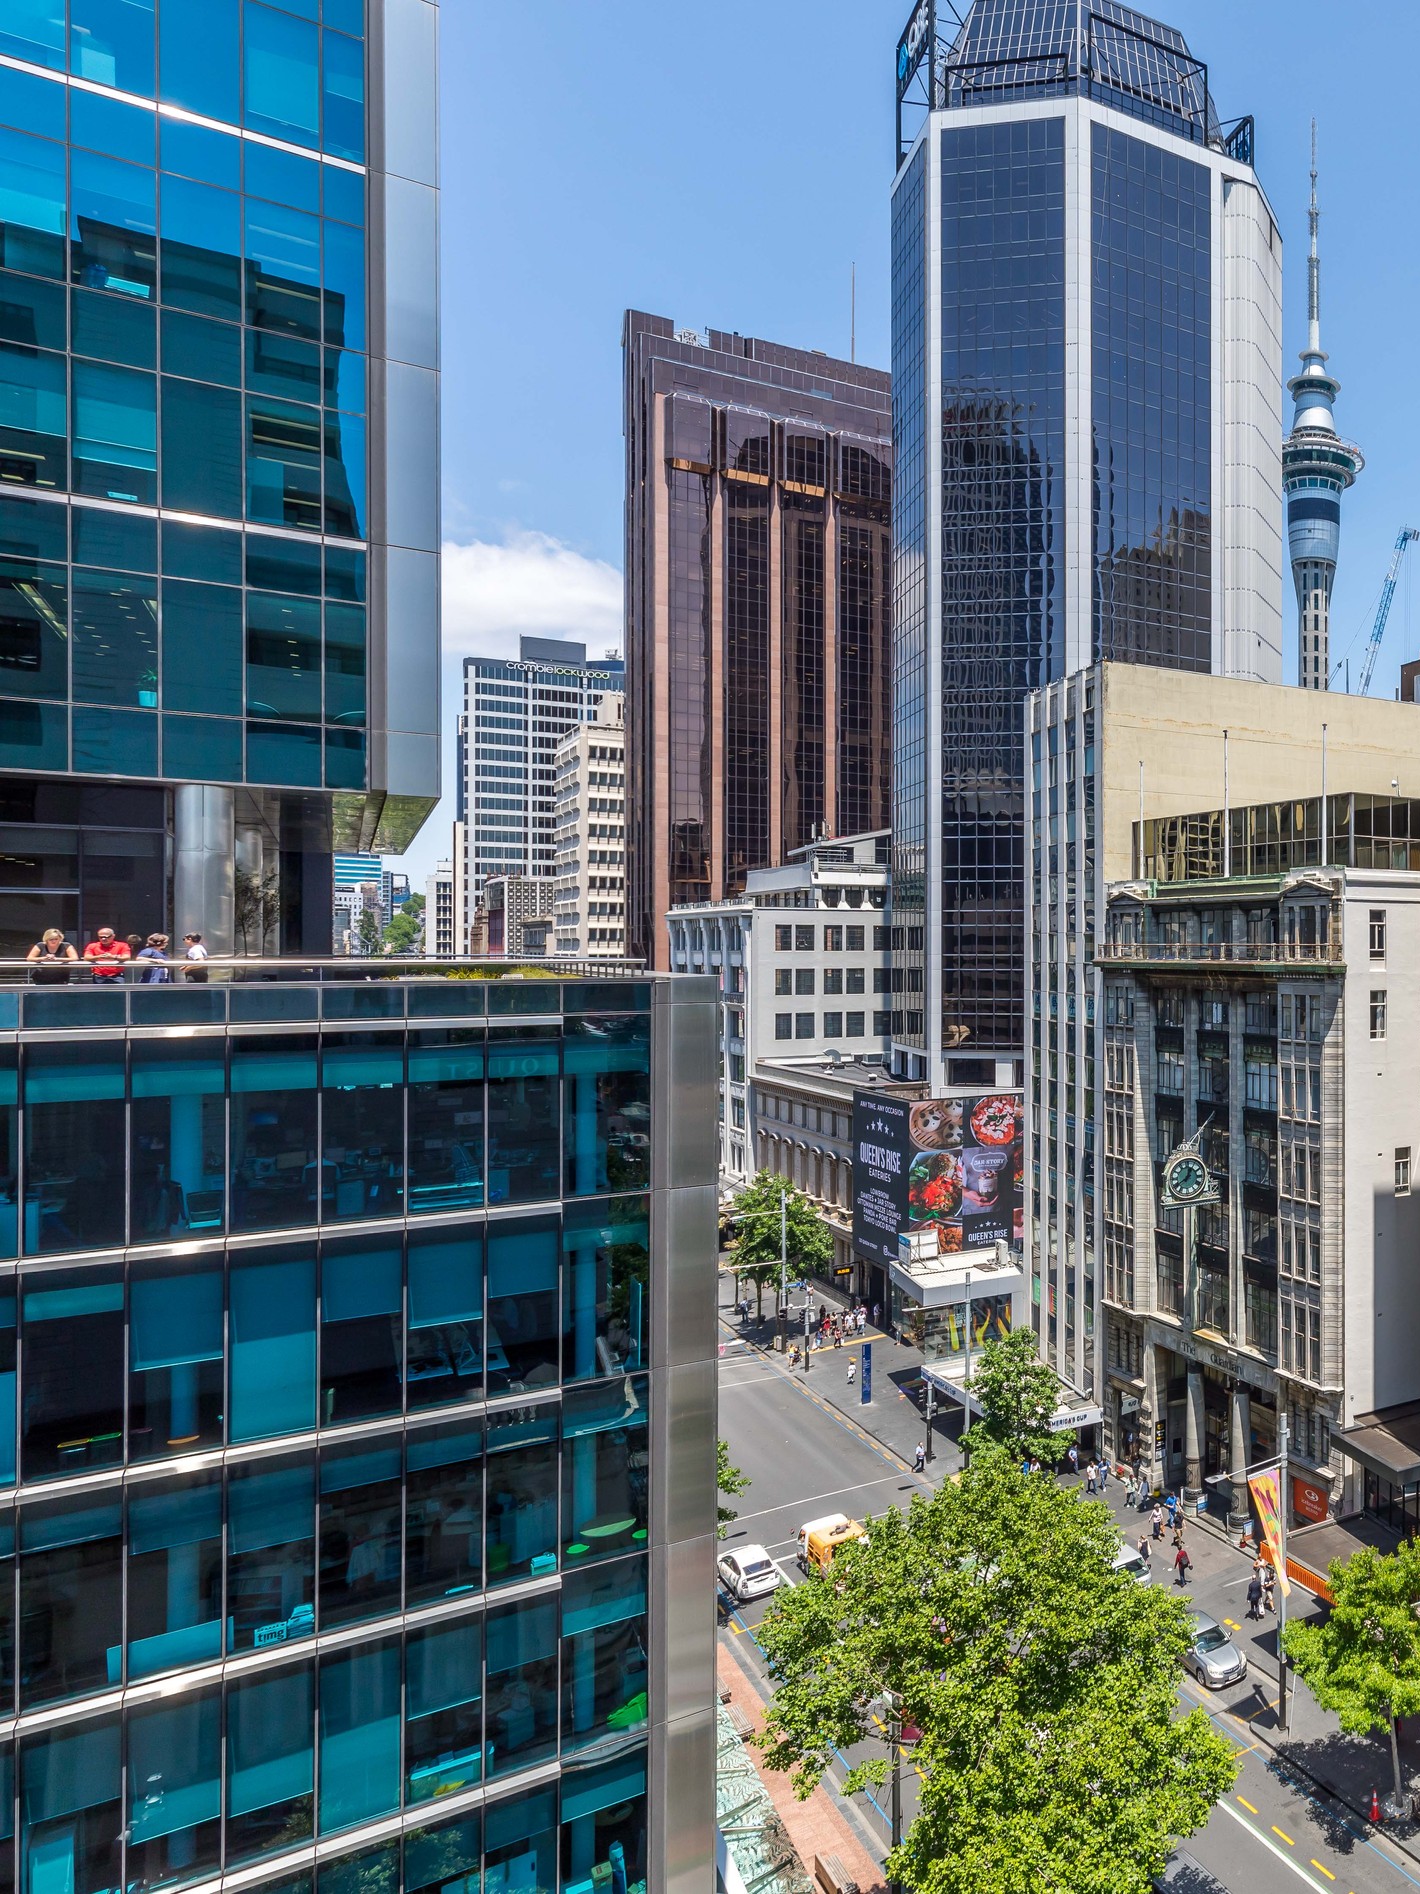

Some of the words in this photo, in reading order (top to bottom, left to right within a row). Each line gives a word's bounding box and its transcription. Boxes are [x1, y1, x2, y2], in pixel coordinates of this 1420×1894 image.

[506, 662, 609, 680] crombielockwood
[884, 1106, 904, 1116] OCCASION
[860, 1141, 885, 1168] QUEEN'S
[886, 1149, 901, 1174] RISE
[869, 1167, 891, 1183] EATERIES
[870, 1187, 889, 1200] LOWBROW
[857, 1197, 873, 1209] OTTOMAN
[874, 1204, 886, 1214] MEZZE
[886, 1208, 901, 1220] LOUNGE
[884, 1200, 896, 1210] STORY
[863, 1206, 875, 1218] PANDA
[879, 1213, 888, 1223] POKE
[889, 1217, 897, 1226] BAR
[864, 1214, 875, 1224] TOKYO
[875, 1220, 885, 1229] LOCO
[885, 1223, 897, 1234] BOWL
[968, 1230, 993, 1242] QUEEN'S
[993, 1228, 1008, 1238] RISE
[1182, 1341, 1196, 1355] The
[1210, 1353, 1243, 1377] Guardian
[1076, 1413, 1087, 1423] CUP
